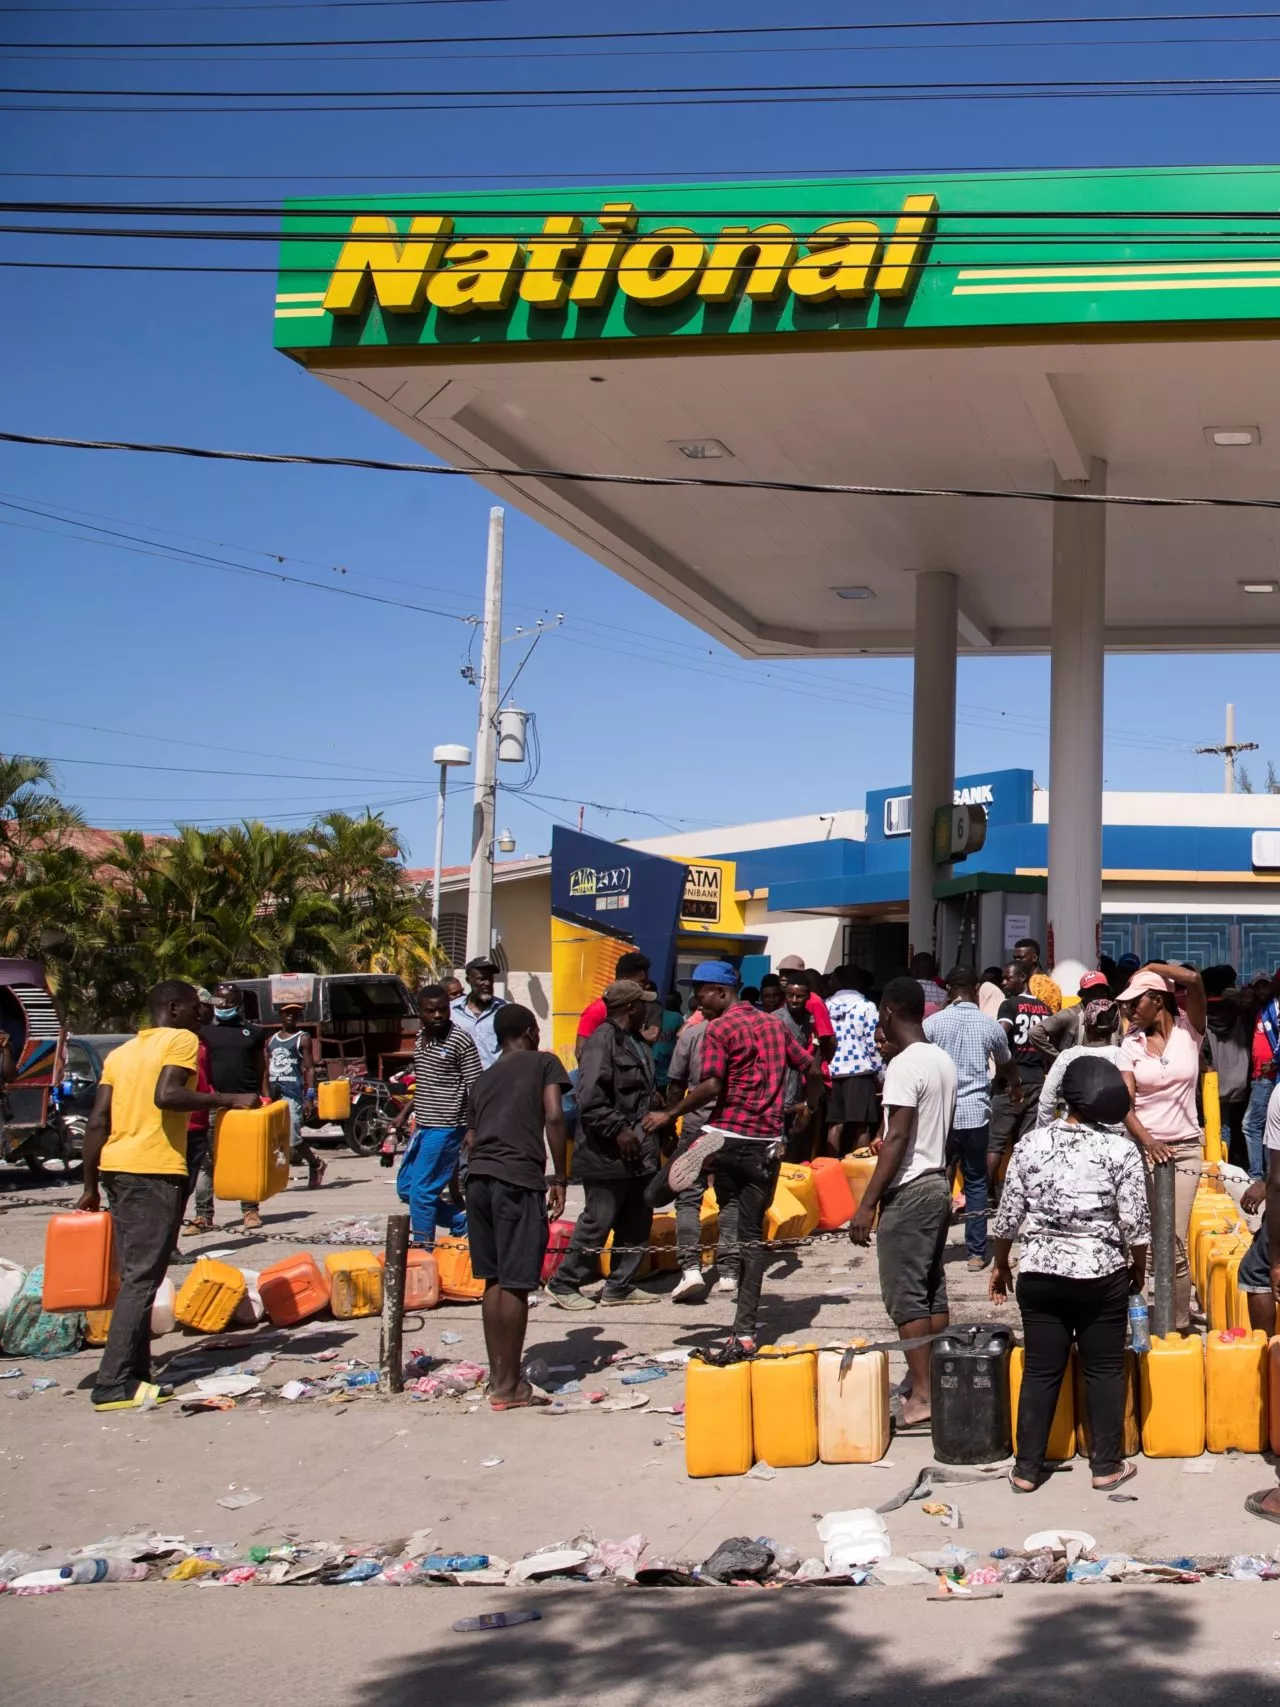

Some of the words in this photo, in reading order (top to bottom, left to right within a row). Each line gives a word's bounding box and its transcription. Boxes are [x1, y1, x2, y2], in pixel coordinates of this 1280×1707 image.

[321, 194, 937, 315] National
[953, 784, 994, 806] BANK
[957, 817, 964, 839] 6
[686, 869, 718, 889] ATM
[1018, 1003, 1050, 1015] PITBULL
